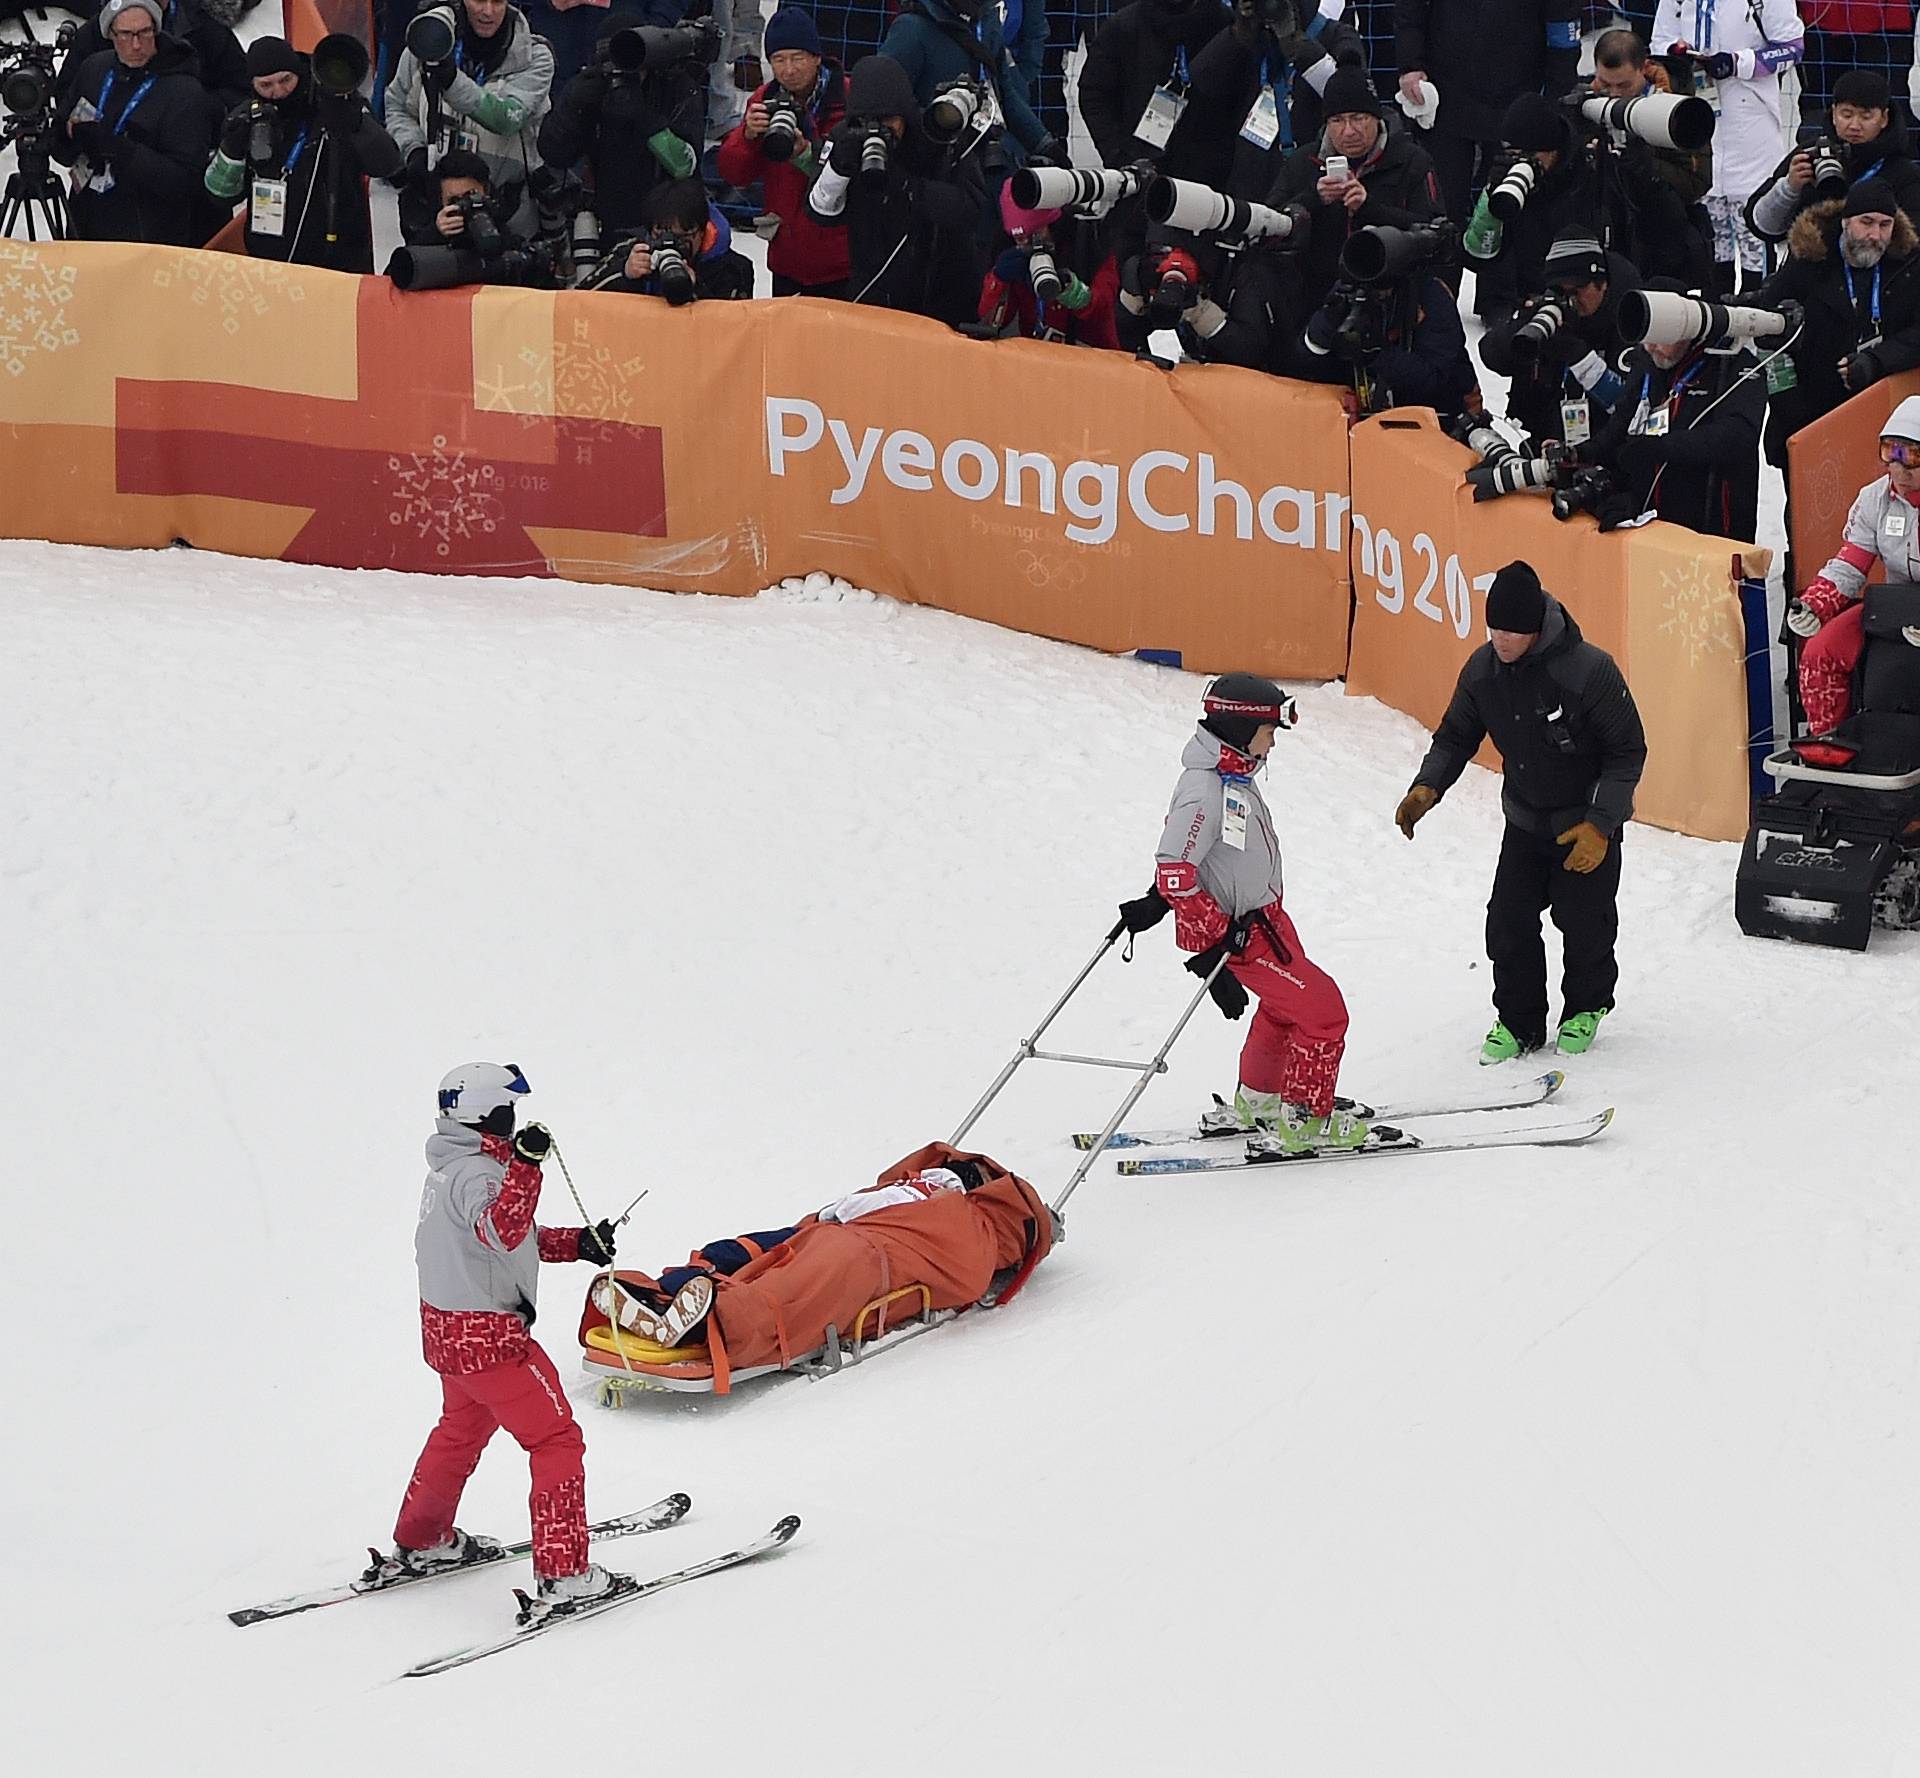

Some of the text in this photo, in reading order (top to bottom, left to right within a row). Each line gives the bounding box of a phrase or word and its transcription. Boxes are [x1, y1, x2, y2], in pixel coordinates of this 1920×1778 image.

[766, 396, 1404, 615] PyeongChang
[1212, 702, 1272, 713] SWANS
[1188, 812, 1206, 841] 2018
